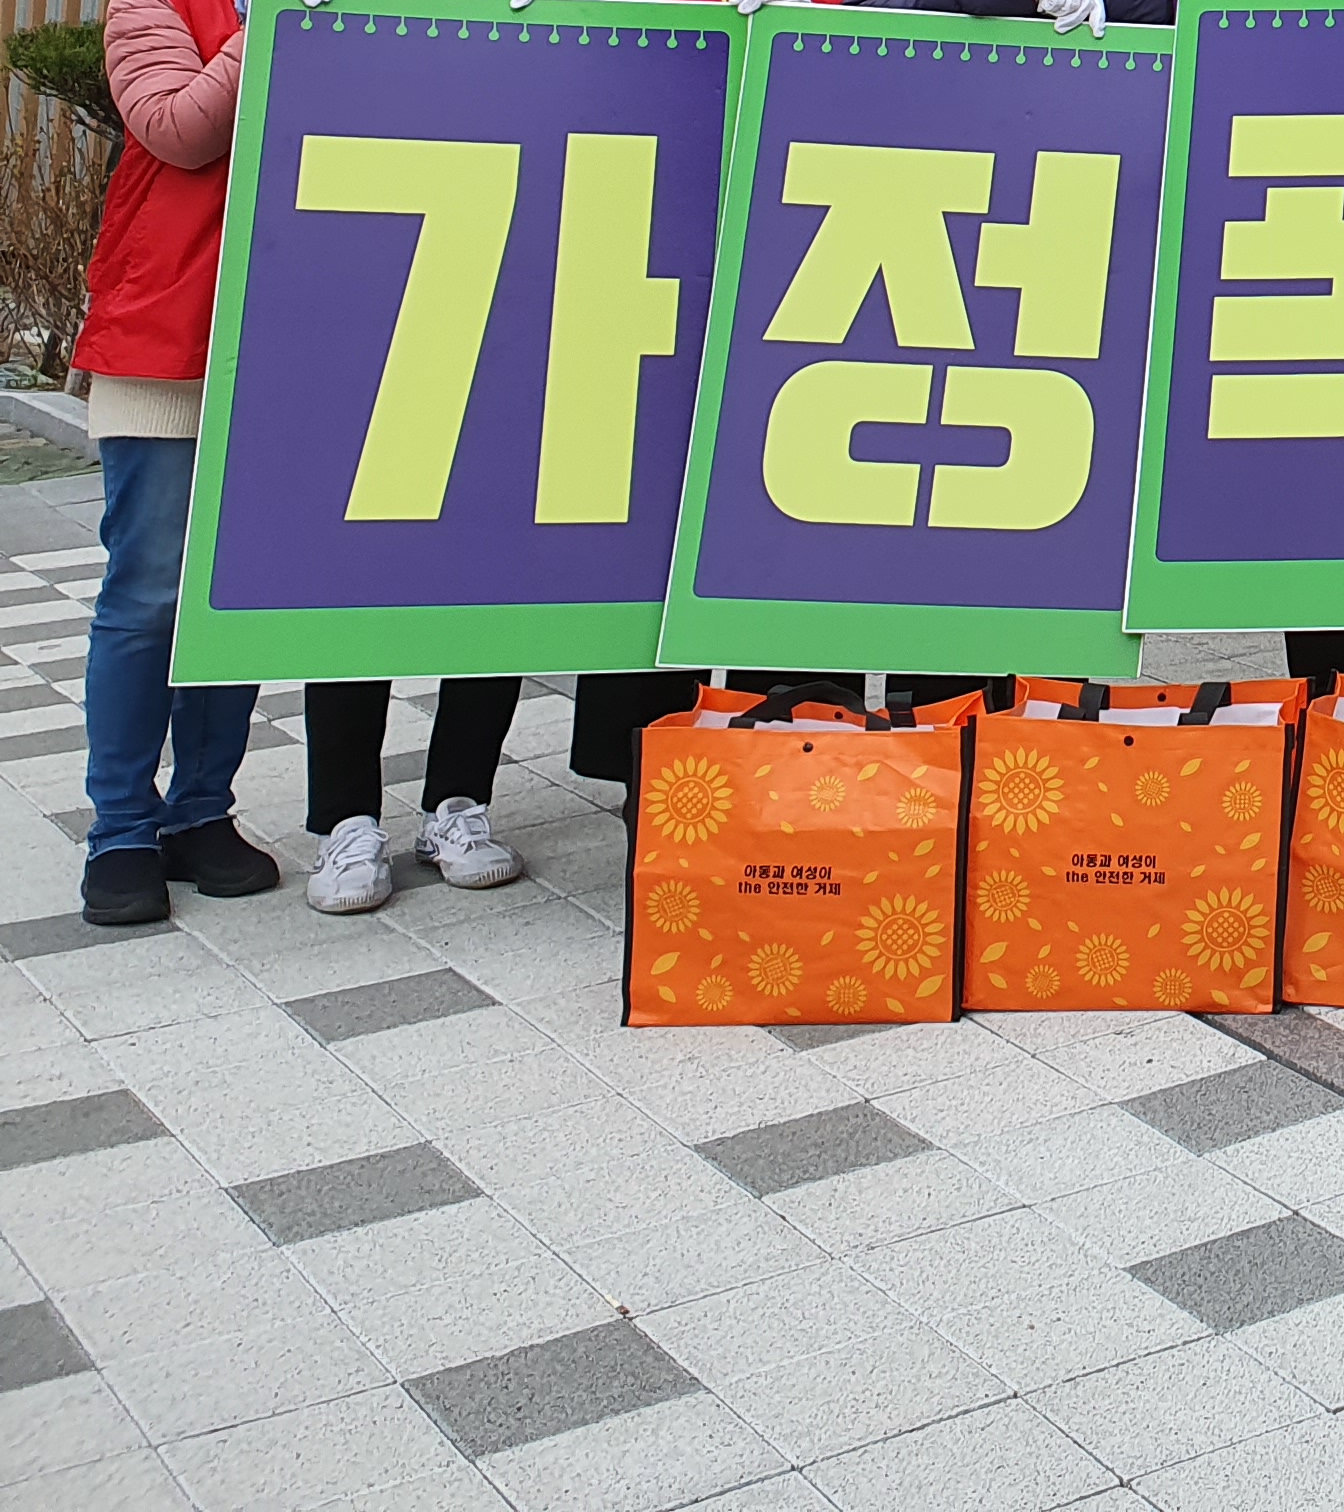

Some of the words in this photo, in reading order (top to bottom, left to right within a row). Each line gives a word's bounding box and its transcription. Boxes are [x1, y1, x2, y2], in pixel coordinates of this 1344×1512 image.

[1071, 853, 1112, 868] 아동과
[1118, 854, 1157, 869] 여성이
[745, 864, 785, 879] 아동과
[791, 866, 832, 880] 여성이
[1066, 871, 1089, 883] the
[1094, 870, 1134, 885] 안전한
[1139, 871, 1166, 885] 거제
[738, 881, 762, 894] the
[768, 882, 810, 895] 안전한
[814, 883, 841, 896] 거제
